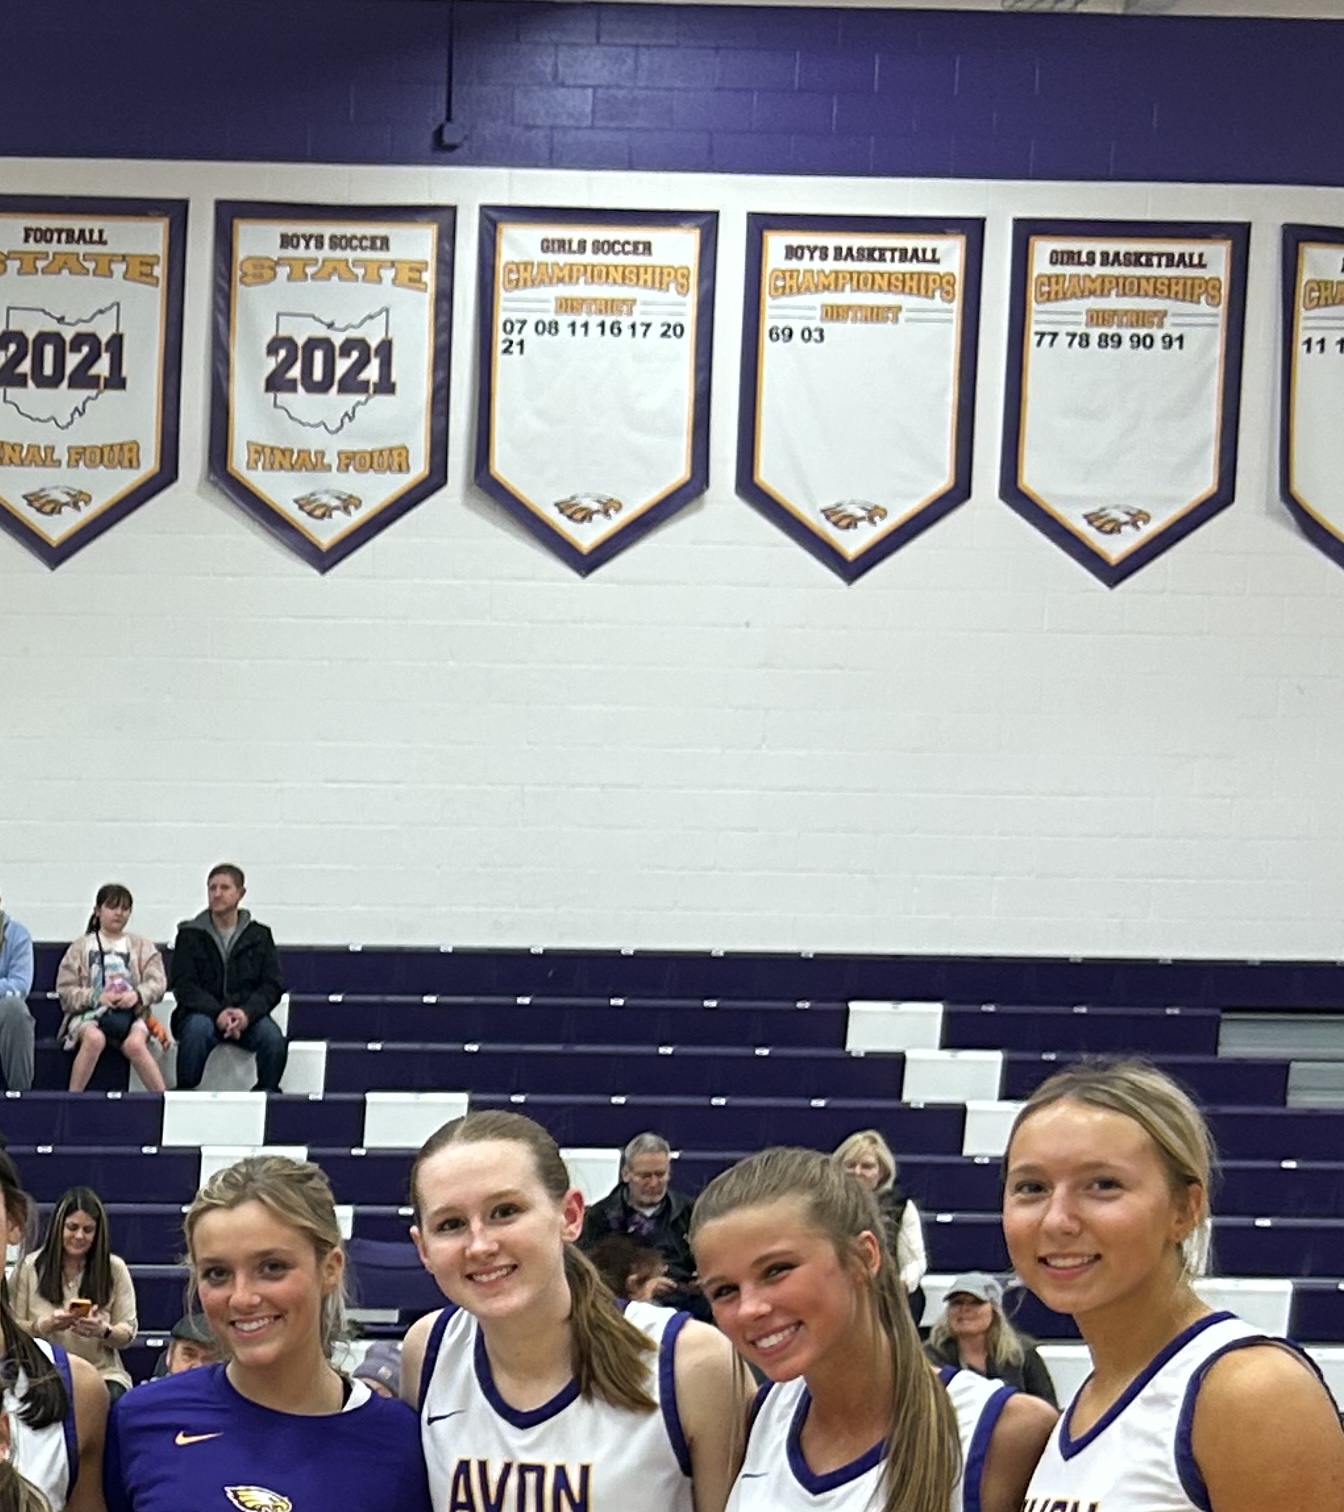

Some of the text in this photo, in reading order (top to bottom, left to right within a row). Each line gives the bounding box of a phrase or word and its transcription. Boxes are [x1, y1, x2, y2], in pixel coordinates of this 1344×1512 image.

[23, 227, 108, 246] FOOTBALL
[329, 232, 390, 252] SOCCER
[540, 237, 653, 257] GIRLS SOCCER
[785, 244, 940, 264] BOYS BASKETBALL
[1049, 249, 1207, 270] GIRLS BASKETBALL
[239, 256, 429, 292] STATE
[502, 262, 691, 296] CHAMPIONSHIPS
[768, 268, 955, 303] CHAMPIONSHIPS
[1034, 273, 1222, 308] CHAMPIONSHIPS
[554, 296, 637, 316] DISTRICT
[820, 303, 903, 324] DISTRICT
[1085, 308, 1168, 329] DISTRICT
[502, 319, 685, 339] 07 08 11 16 17 20
[768, 326, 826, 344] 69 03
[501, 339, 525, 356] 21
[1034, 331, 1185, 351] 77 78 89 90 91
[1302, 337, 1325, 354] 11
[265, 335, 396, 394] 2021
[67, 440, 140, 469] FOUR
[246, 441, 410, 473] FINAL FOUR
